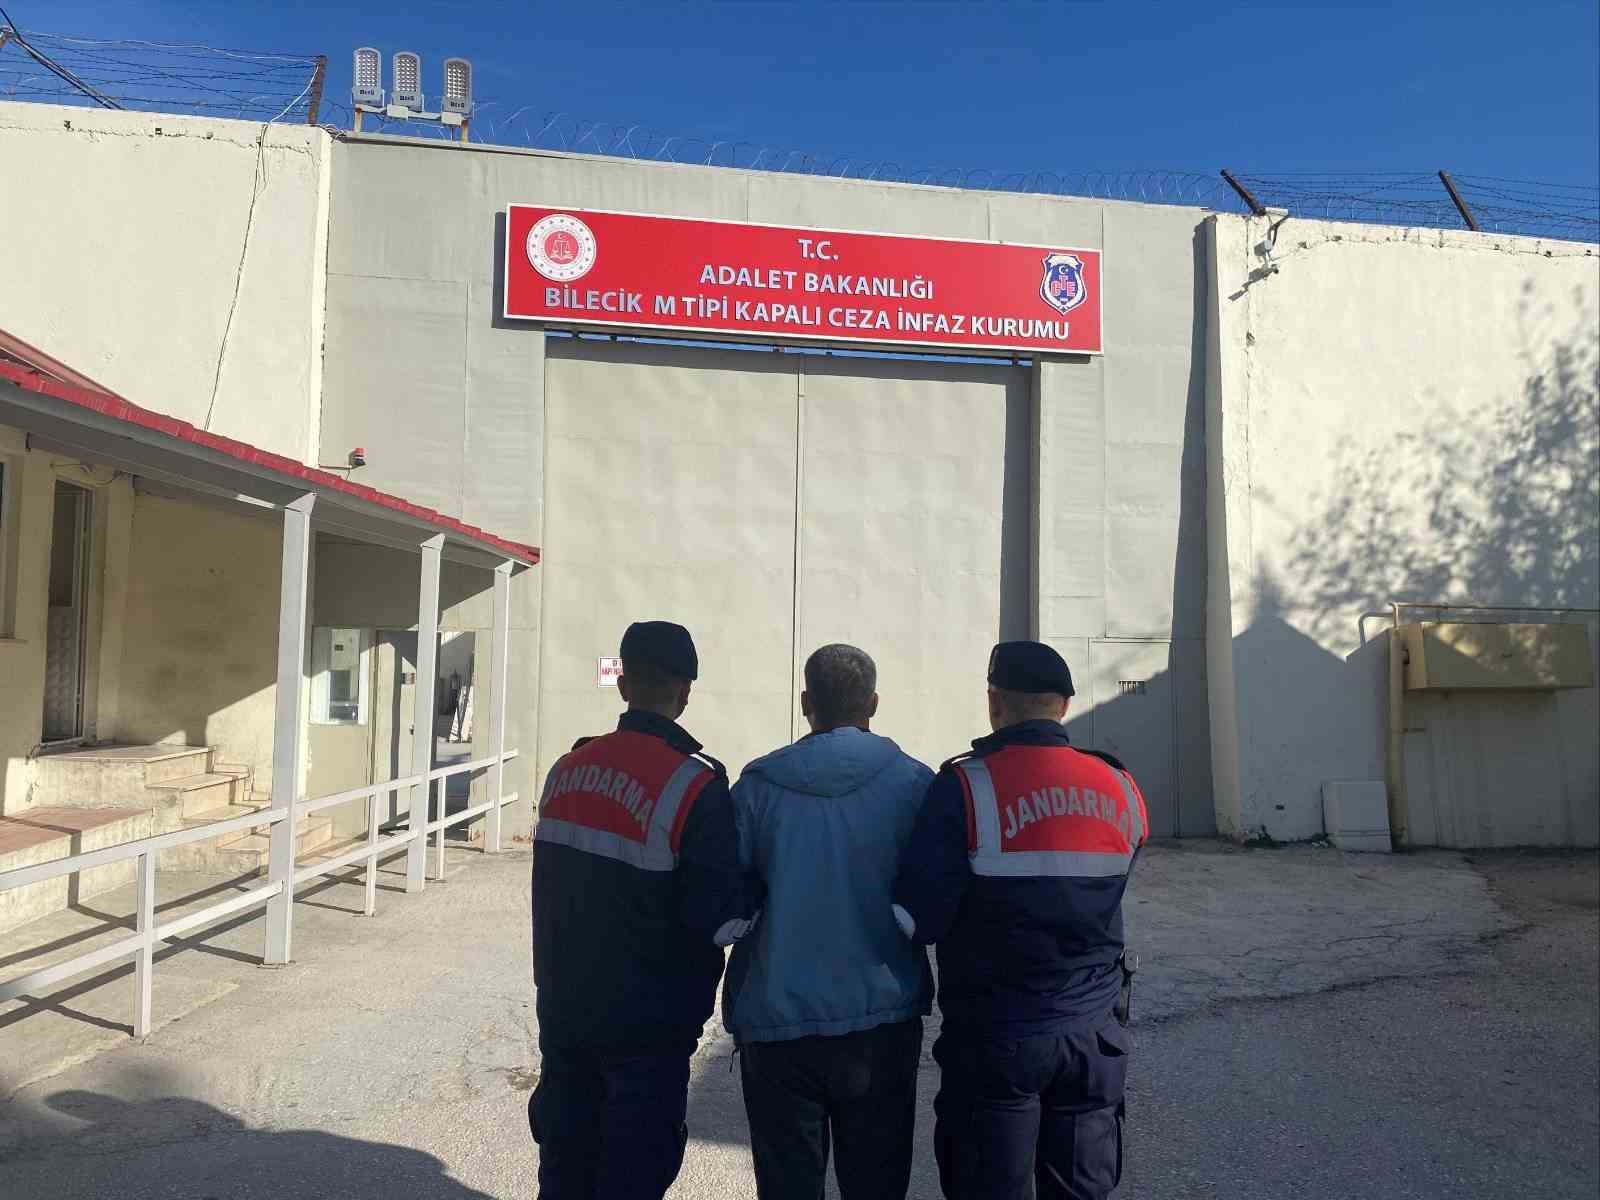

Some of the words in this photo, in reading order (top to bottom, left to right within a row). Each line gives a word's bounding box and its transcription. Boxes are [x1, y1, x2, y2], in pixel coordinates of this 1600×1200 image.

[798, 239, 839, 261] T.C.
[700, 264, 797, 290] ADALET
[803, 272, 934, 300] BAKANLIĞI
[544, 284, 642, 313] BİLECİK
[654, 295, 676, 316] M
[682, 294, 728, 319] TİPİ
[735, 301, 821, 326] KAPALI
[828, 307, 891, 331] CEZA
[897, 307, 966, 335] İNFAZ
[971, 316, 1070, 341] KURUMU
[543, 764, 655, 832] JANDARMA
